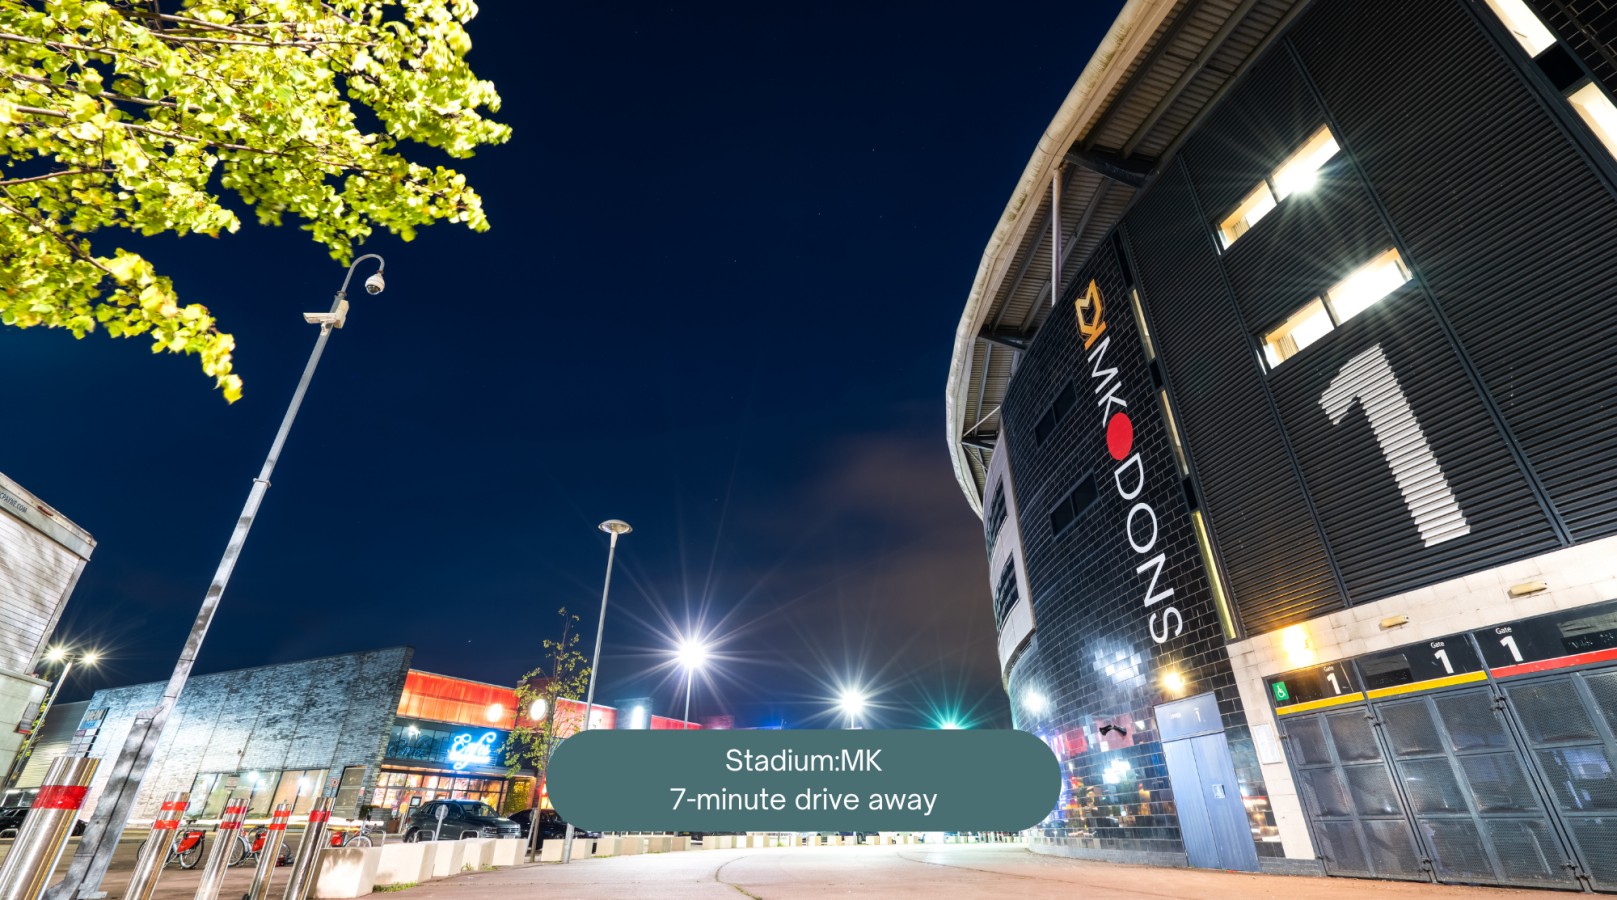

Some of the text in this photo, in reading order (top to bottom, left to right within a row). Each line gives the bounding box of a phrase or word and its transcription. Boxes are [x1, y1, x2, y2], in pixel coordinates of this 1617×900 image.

[1318, 342, 1471, 547] 1
[1087, 336, 1183, 644] MK DONS
[1494, 625, 1513, 635] Gate
[1430, 640, 1445, 649] Gate
[1500, 635, 1524, 662] 1
[1434, 649, 1455, 674] 1
[1326, 672, 1342, 695] 1
